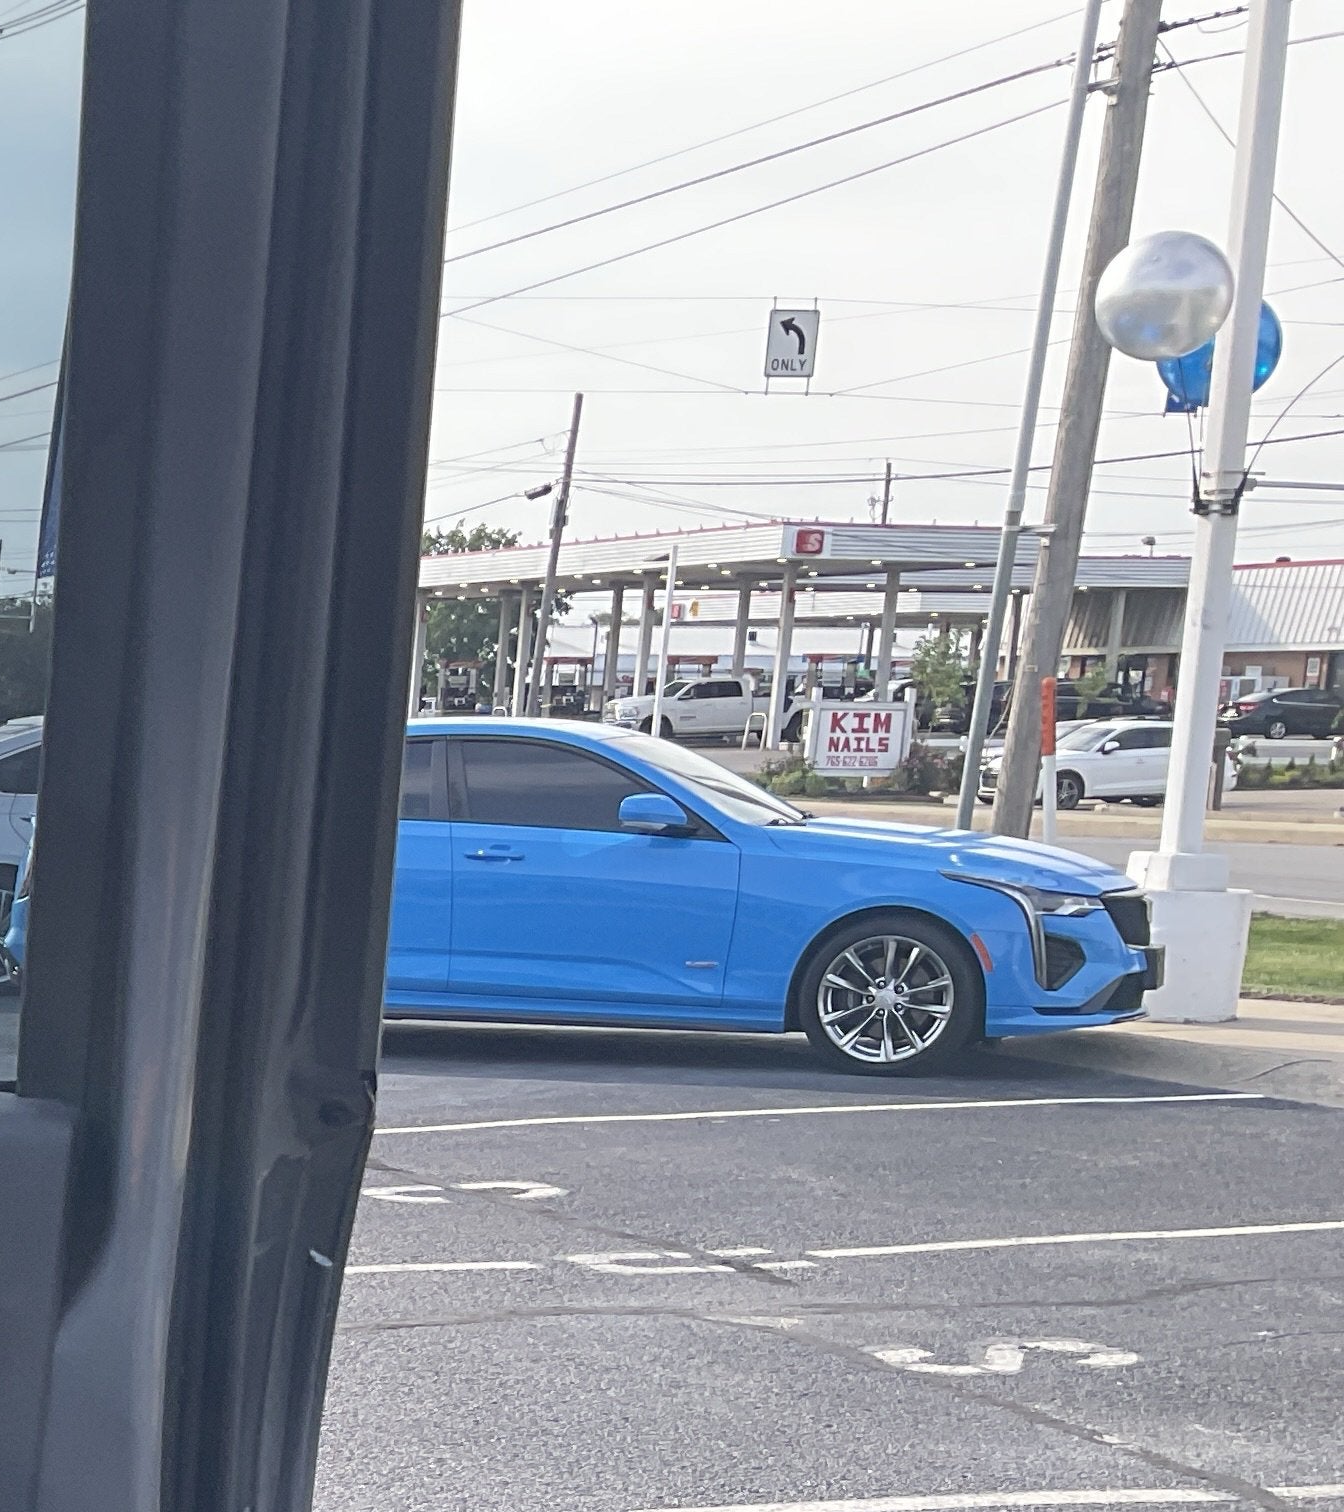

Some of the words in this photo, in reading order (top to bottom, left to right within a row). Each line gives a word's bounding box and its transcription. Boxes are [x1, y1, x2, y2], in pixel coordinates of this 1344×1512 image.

[771, 358, 808, 371] ONLY
[830, 711, 892, 734] KIM
[828, 737, 889, 753] NAILS
